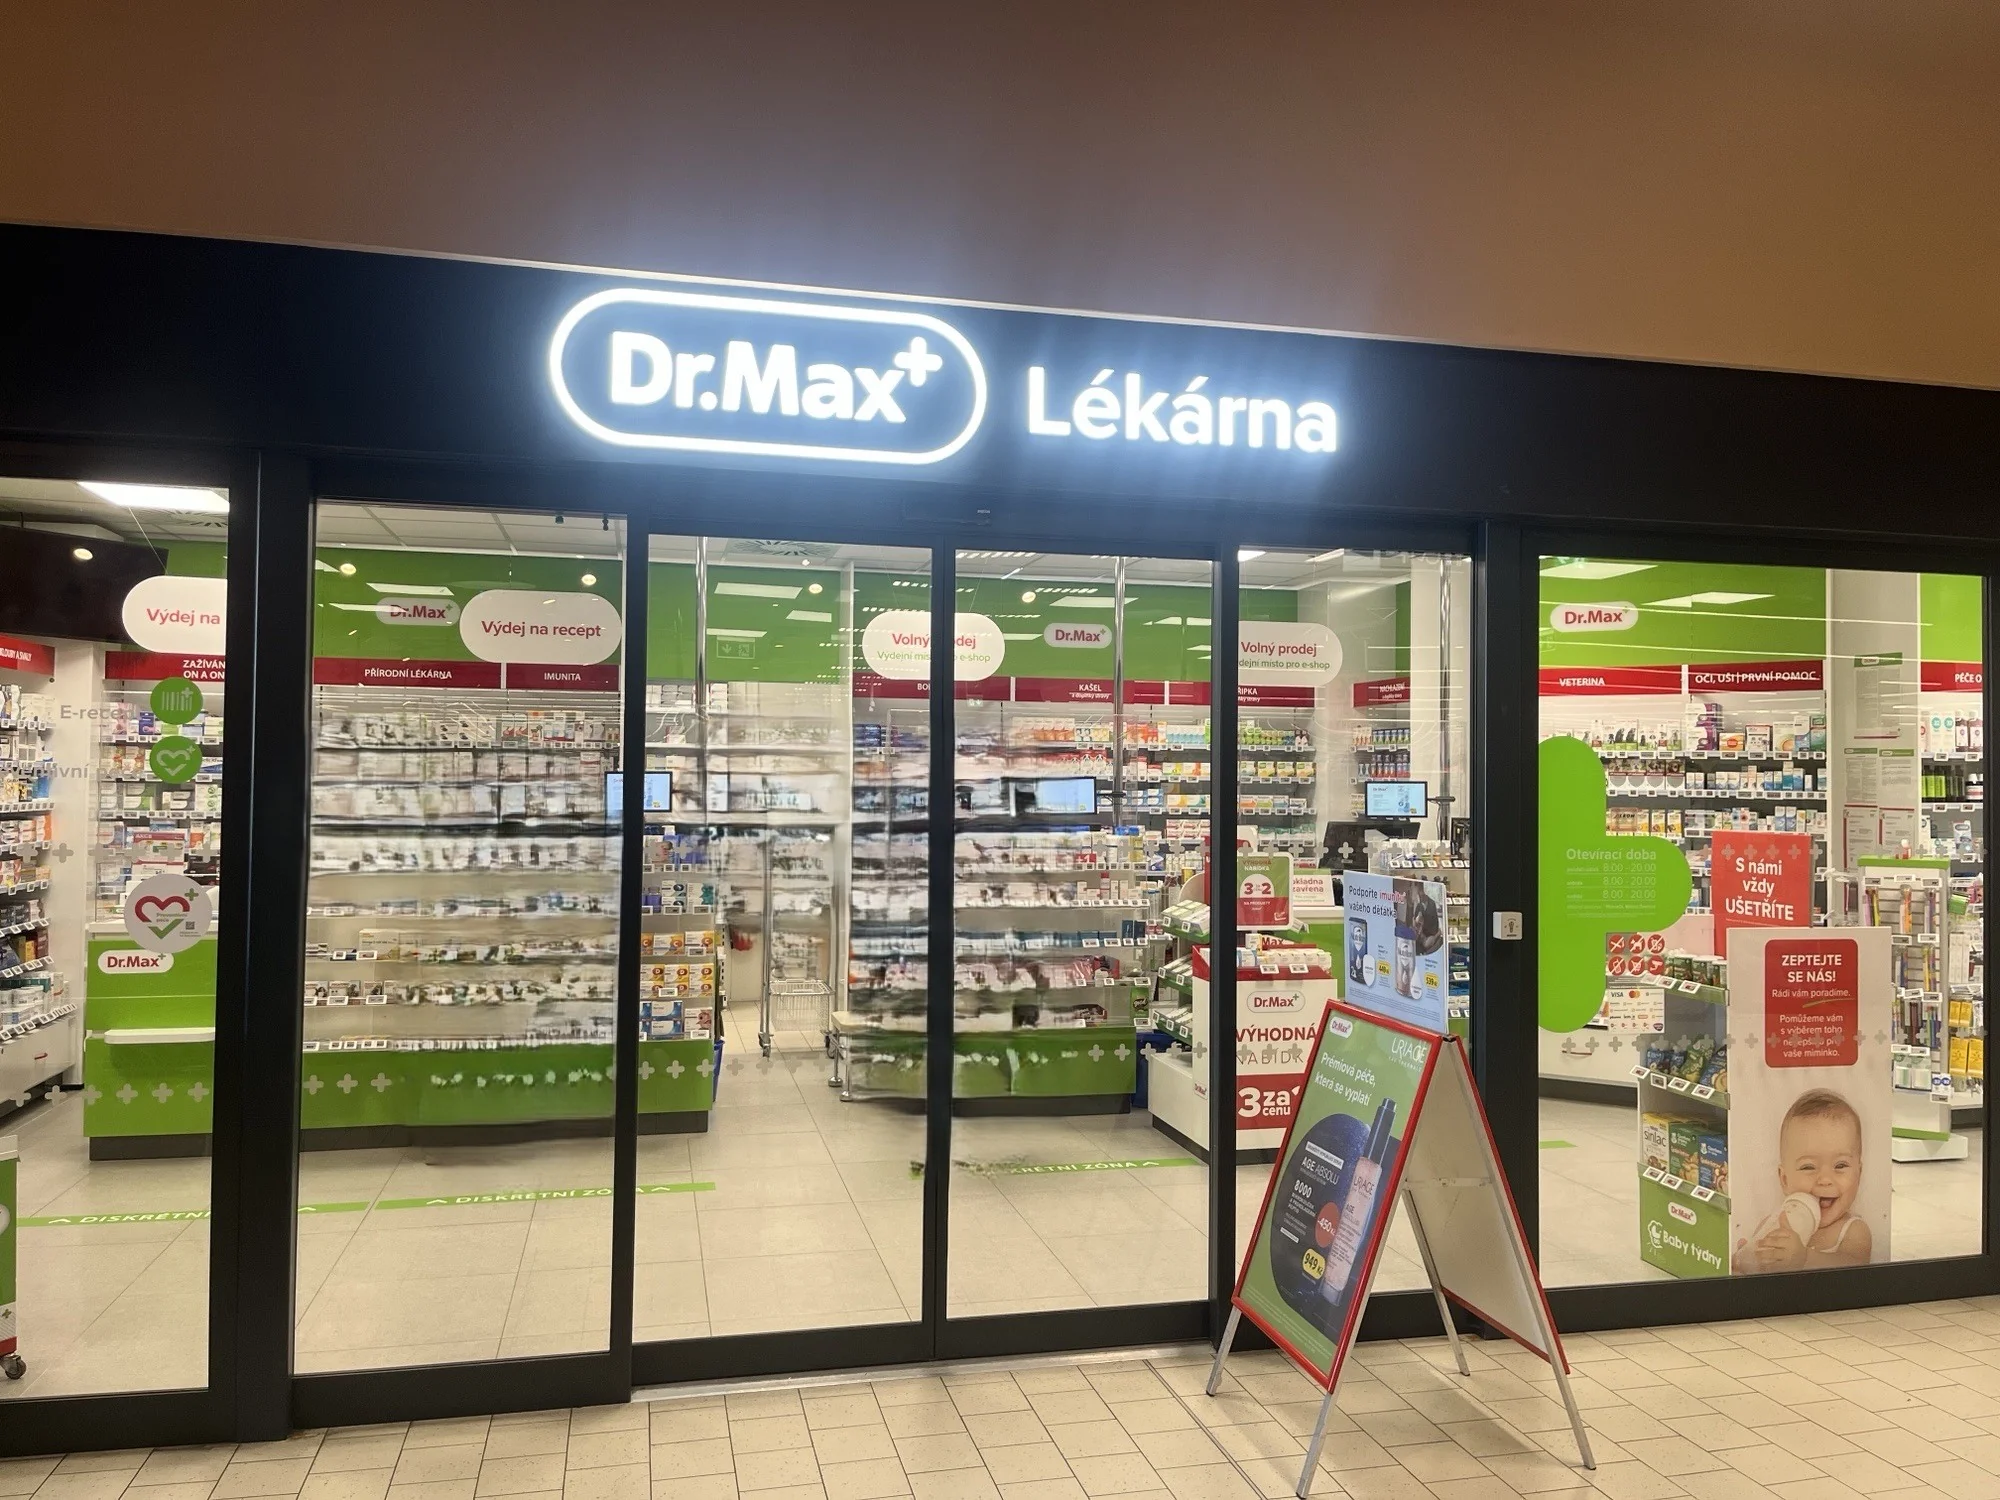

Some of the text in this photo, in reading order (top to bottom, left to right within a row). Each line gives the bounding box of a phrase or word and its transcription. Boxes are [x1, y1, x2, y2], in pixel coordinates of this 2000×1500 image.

[1025, 365, 1339, 455] Lékárna
[147, 608, 220, 626] Výdej na
[481, 620, 601, 639] Výdej na recept
[892, 633, 930, 648] Volný
[1241, 641, 1317, 658] Volný prodej
[959, 653, 991, 662] e-shop
[1261, 659, 1284, 668] místo
[1301, 661, 1331, 670] e-shop
[183, 670, 225, 679] ON A ON
[364, 668, 452, 680] PŘÍRODNÍ LÉKÁRNA
[544, 672, 581, 681] IMUNITA
[1741, 670, 1774, 682] PRVNÍ
[1954, 673, 1974, 683] PÉČE
[1078, 683, 1102, 692] KAŠEL
[1559, 677, 1605, 688] VETERINA
[1566, 848, 1657, 860] Otevírací doba
[1735, 856, 1782, 876] S námi
[1292, 877, 1324, 886] okladna
[1742, 876, 1775, 897] vždy
[1244, 882, 1254, 895] 3
[1261, 882, 1272, 895] 2
[1349, 885, 1378, 899] Podpořte
[1725, 895, 1794, 921] UŠETŘÍTE
[1781, 954, 1842, 966] ZEPTEJTE
[1787, 968, 1836, 982] SE NÁS!
[1772, 987, 1851, 998] Rádi vám poradíme.
[1780, 1014, 1844, 1023] Pomůžeme vám
[1236, 1024, 1317, 1042] VÝHODNÁ
[1783, 1049, 1803, 1058] vaše
[1321, 1052, 1356, 1077] Prémiová
[1315, 1071, 1372, 1106] která se vyplatí
[1238, 1086, 1290, 1118] 3 za
[1262, 1106, 1291, 1116] cenu
[1083, 1162, 1138, 1171] ZÓNA
[1294, 1179, 1313, 1199] 8000
[455, 1189, 576, 1204] DISKRÉTNÍ
[1663, 1229, 1722, 1270] Baby týdny
[1304, 1252, 1319, 1271] 949
